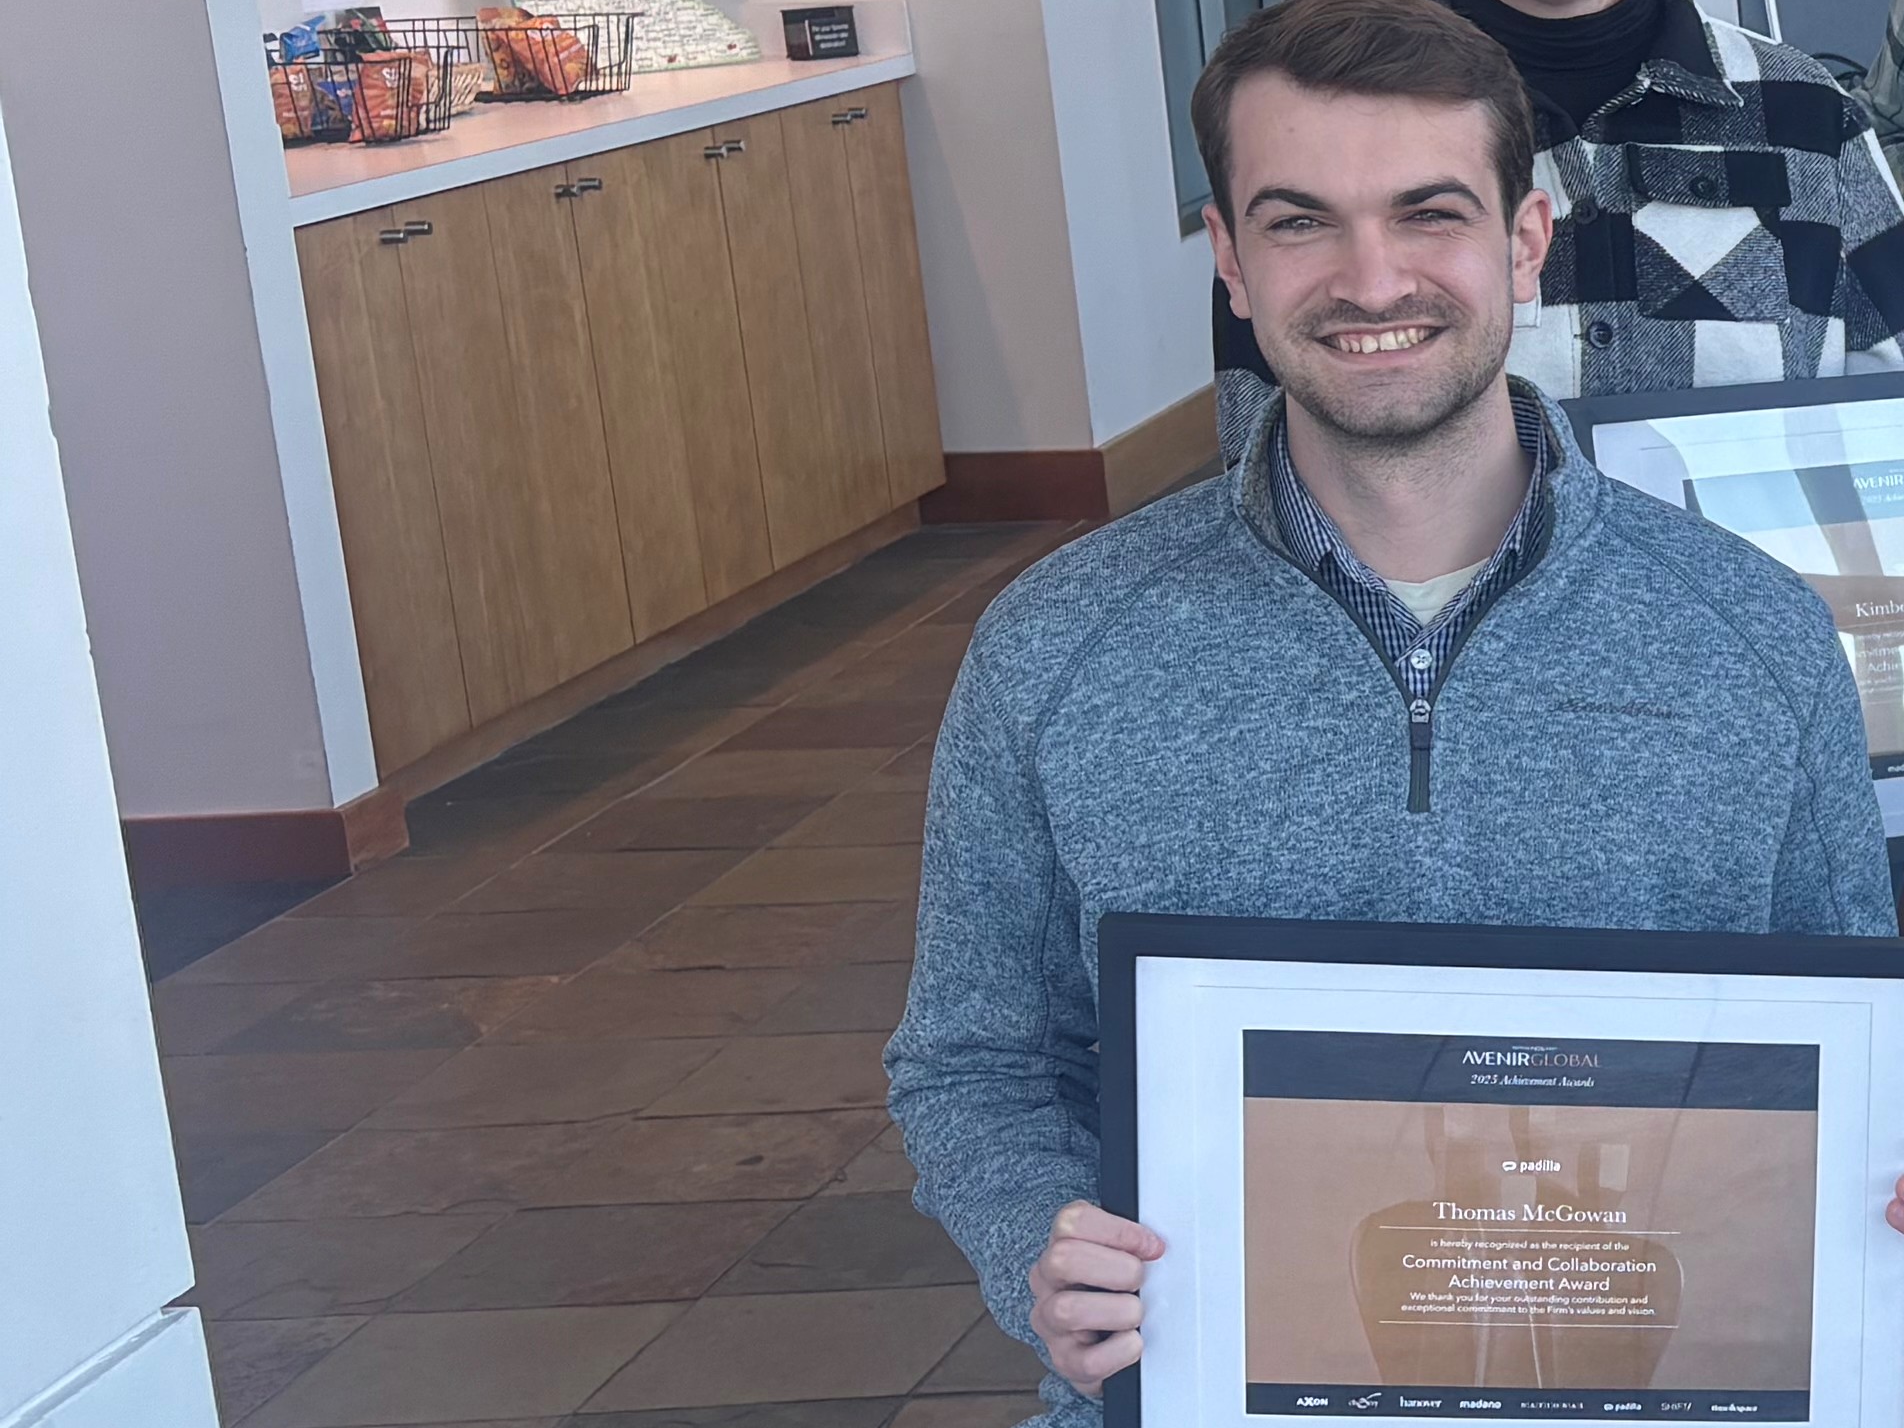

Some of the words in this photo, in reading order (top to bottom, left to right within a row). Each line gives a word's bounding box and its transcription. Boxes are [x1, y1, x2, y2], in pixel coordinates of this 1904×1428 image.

[1470, 1073, 1499, 1085] 2025
[1519, 1158, 1561, 1173] padilla
[1432, 1201, 1516, 1221] Thomas
[1522, 1203, 1627, 1223] McGowan
[1402, 1253, 1508, 1270] Commitment
[1512, 1256, 1544, 1271] and
[1547, 1256, 1657, 1273] Collaboration
[1448, 1275, 1555, 1291] Achievement
[1558, 1275, 1610, 1292] Award
[1297, 1396, 1329, 1406] AXON
[1459, 1399, 1502, 1409] madano
